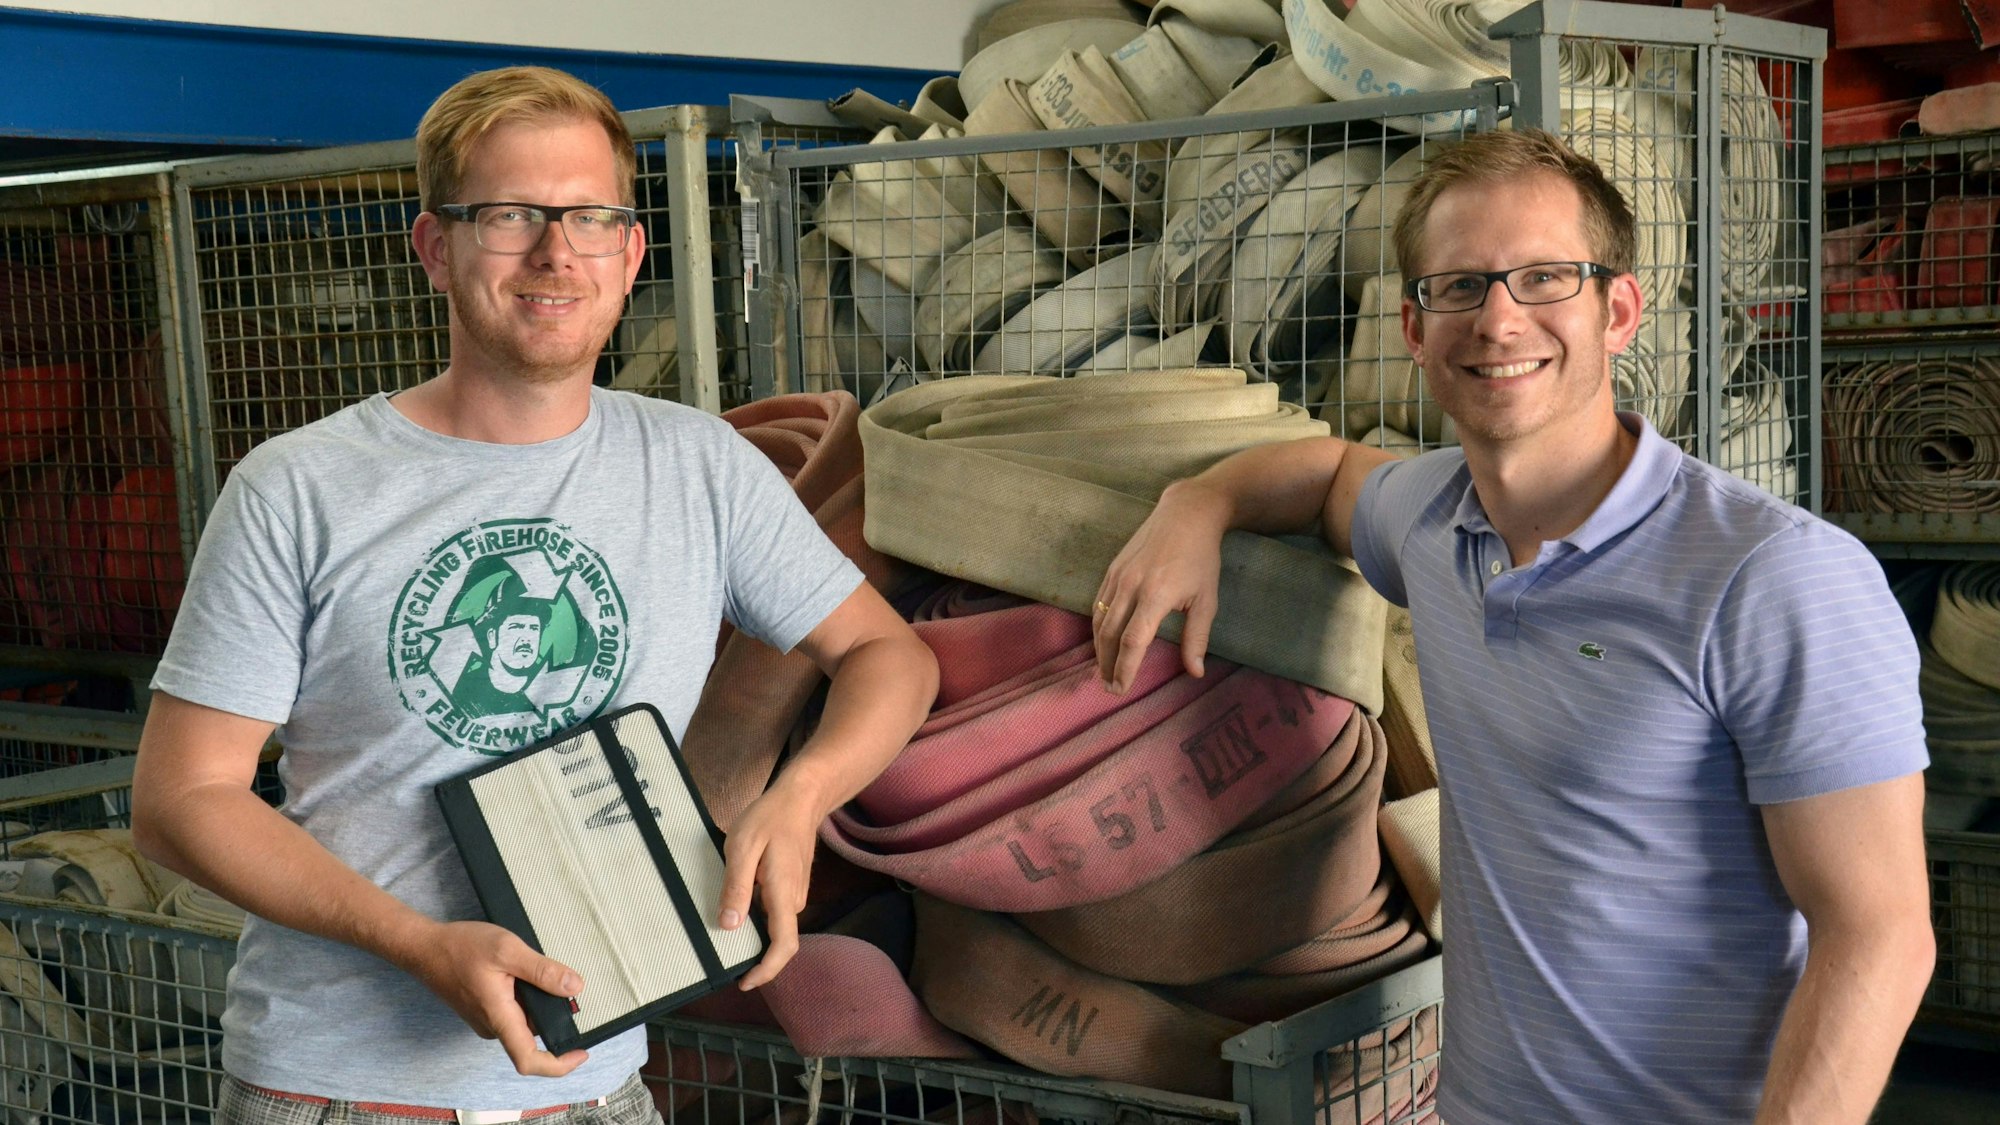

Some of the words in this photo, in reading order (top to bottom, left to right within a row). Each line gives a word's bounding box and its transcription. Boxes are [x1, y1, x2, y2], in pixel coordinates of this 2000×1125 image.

[1172, 153, 1297, 257] SEGEBERG
[458, 526, 575, 562] FIREHOSE
[400, 550, 462, 680] RECYCLING
[571, 552, 617, 620] SINCE
[591, 624, 620, 683] 2005
[425, 698, 582, 748] FEUERWEAR
[1006, 838, 1088, 884] LS
[1088, 772, 1167, 851] 57
[1010, 984, 1099, 1058] MN
